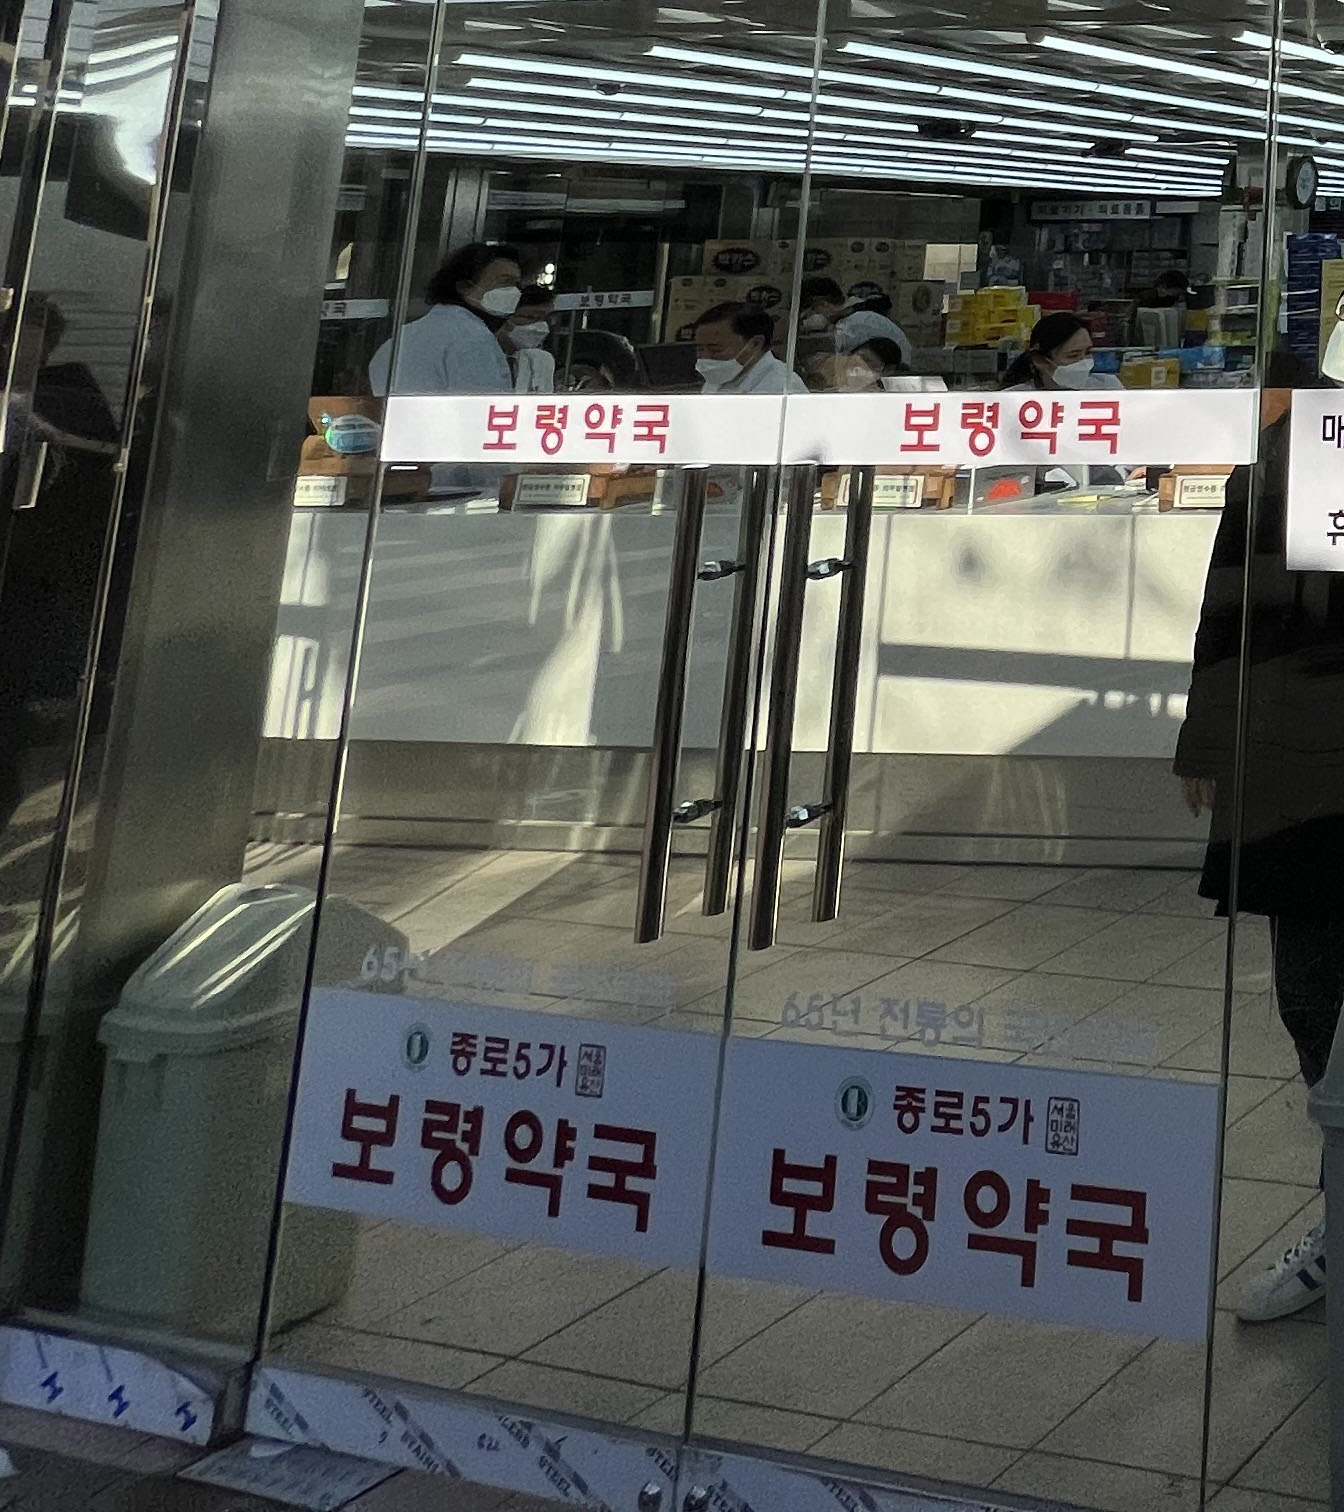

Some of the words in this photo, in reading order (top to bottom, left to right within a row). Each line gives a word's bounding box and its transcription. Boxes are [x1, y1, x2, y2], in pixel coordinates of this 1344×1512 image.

[482, 402, 671, 456] 보령약국
[899, 400, 1122, 458] 보령약국
[878, 996, 988, 1048] 전통의
[449, 1031, 568, 1089] 종로5가
[892, 1084, 1035, 1146] 종로5가
[331, 1087, 657, 1233] 보령약국
[761, 1147, 1150, 1303] 보령약국
